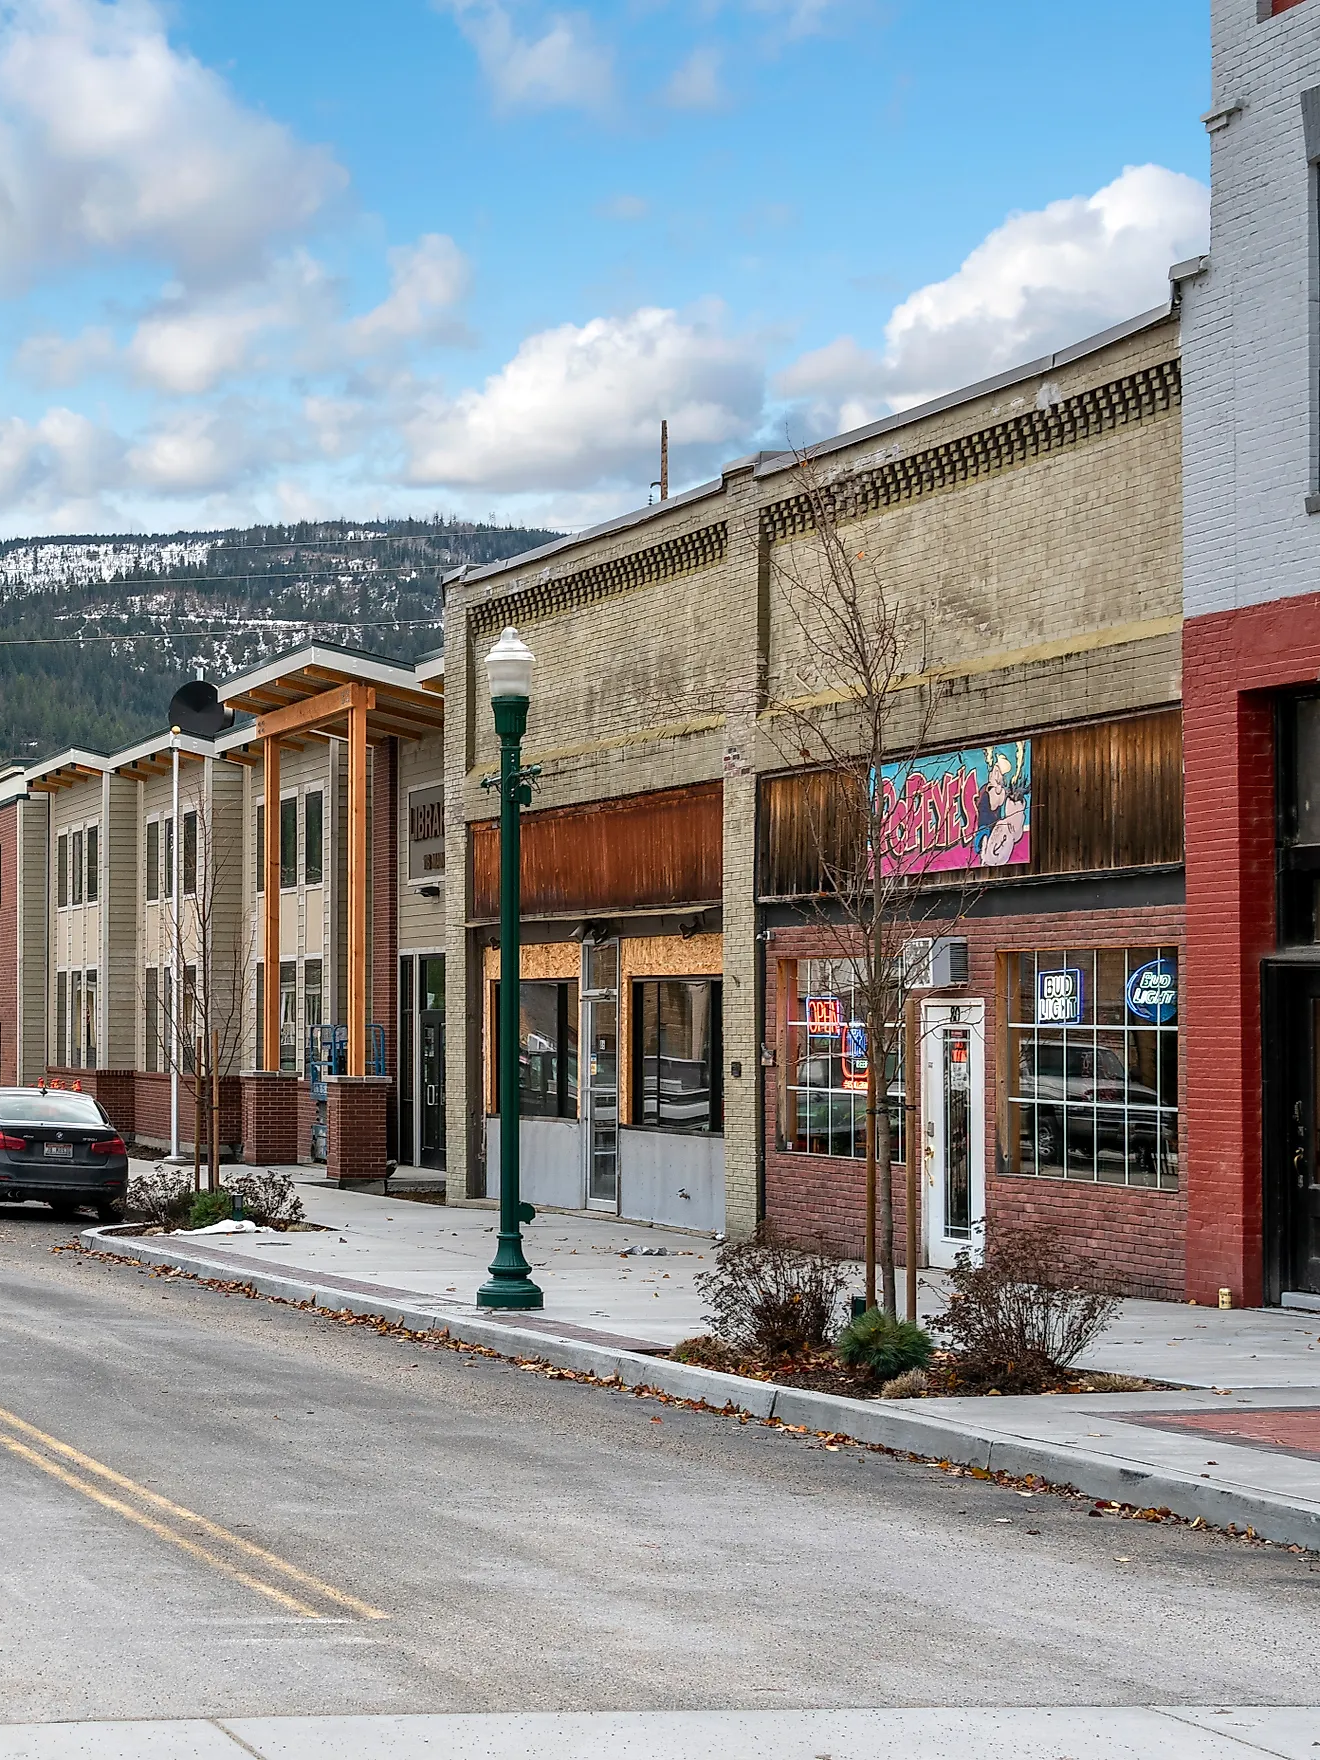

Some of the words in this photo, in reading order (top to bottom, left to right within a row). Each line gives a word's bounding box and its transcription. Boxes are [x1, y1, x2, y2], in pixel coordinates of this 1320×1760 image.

[1044, 976, 1072, 998] BUD
[1140, 972, 1171, 988] BUD
[1133, 988, 1175, 1004] LIGHT
[808, 1001, 839, 1034] OPEN
[1039, 996, 1078, 1021] LIGHT
